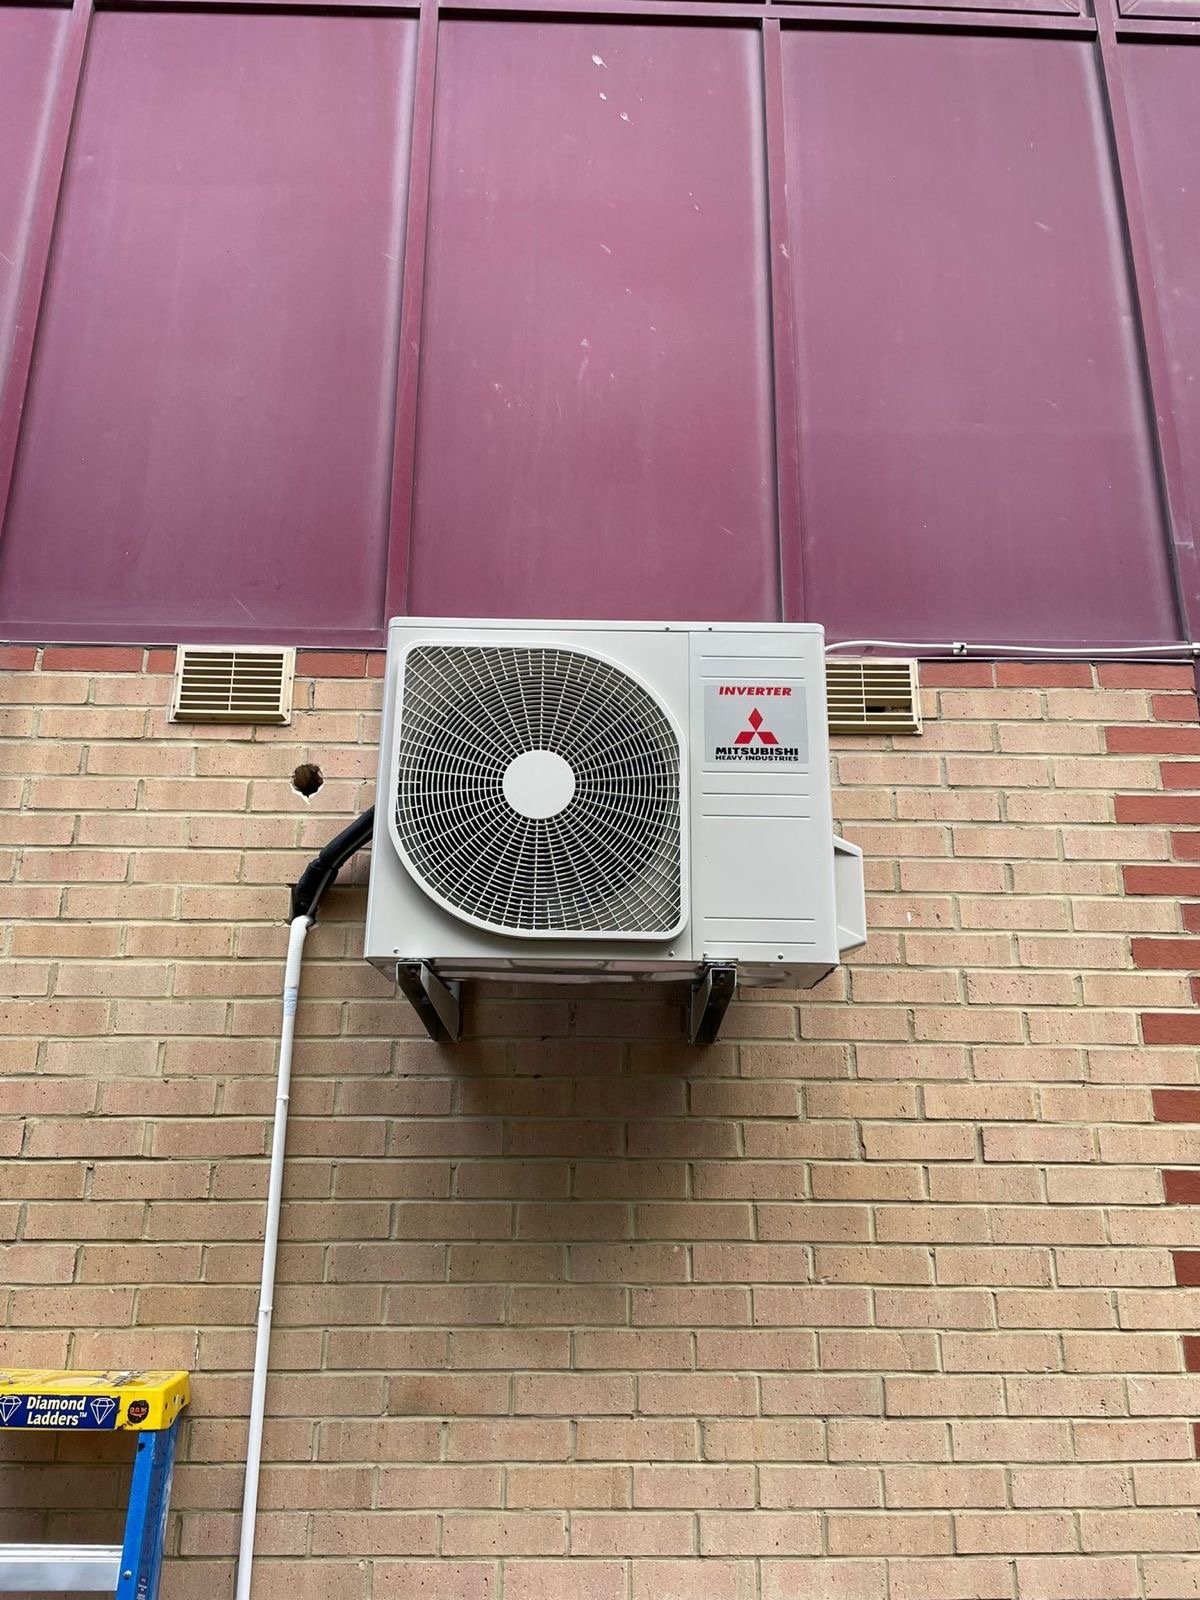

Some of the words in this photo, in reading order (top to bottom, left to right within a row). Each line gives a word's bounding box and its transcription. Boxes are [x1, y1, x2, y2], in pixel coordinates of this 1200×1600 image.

[719, 686, 792, 696] INVERTER
[716, 747, 799, 755] MITSUBISHI
[26, 1396, 87, 1410] Diamond
